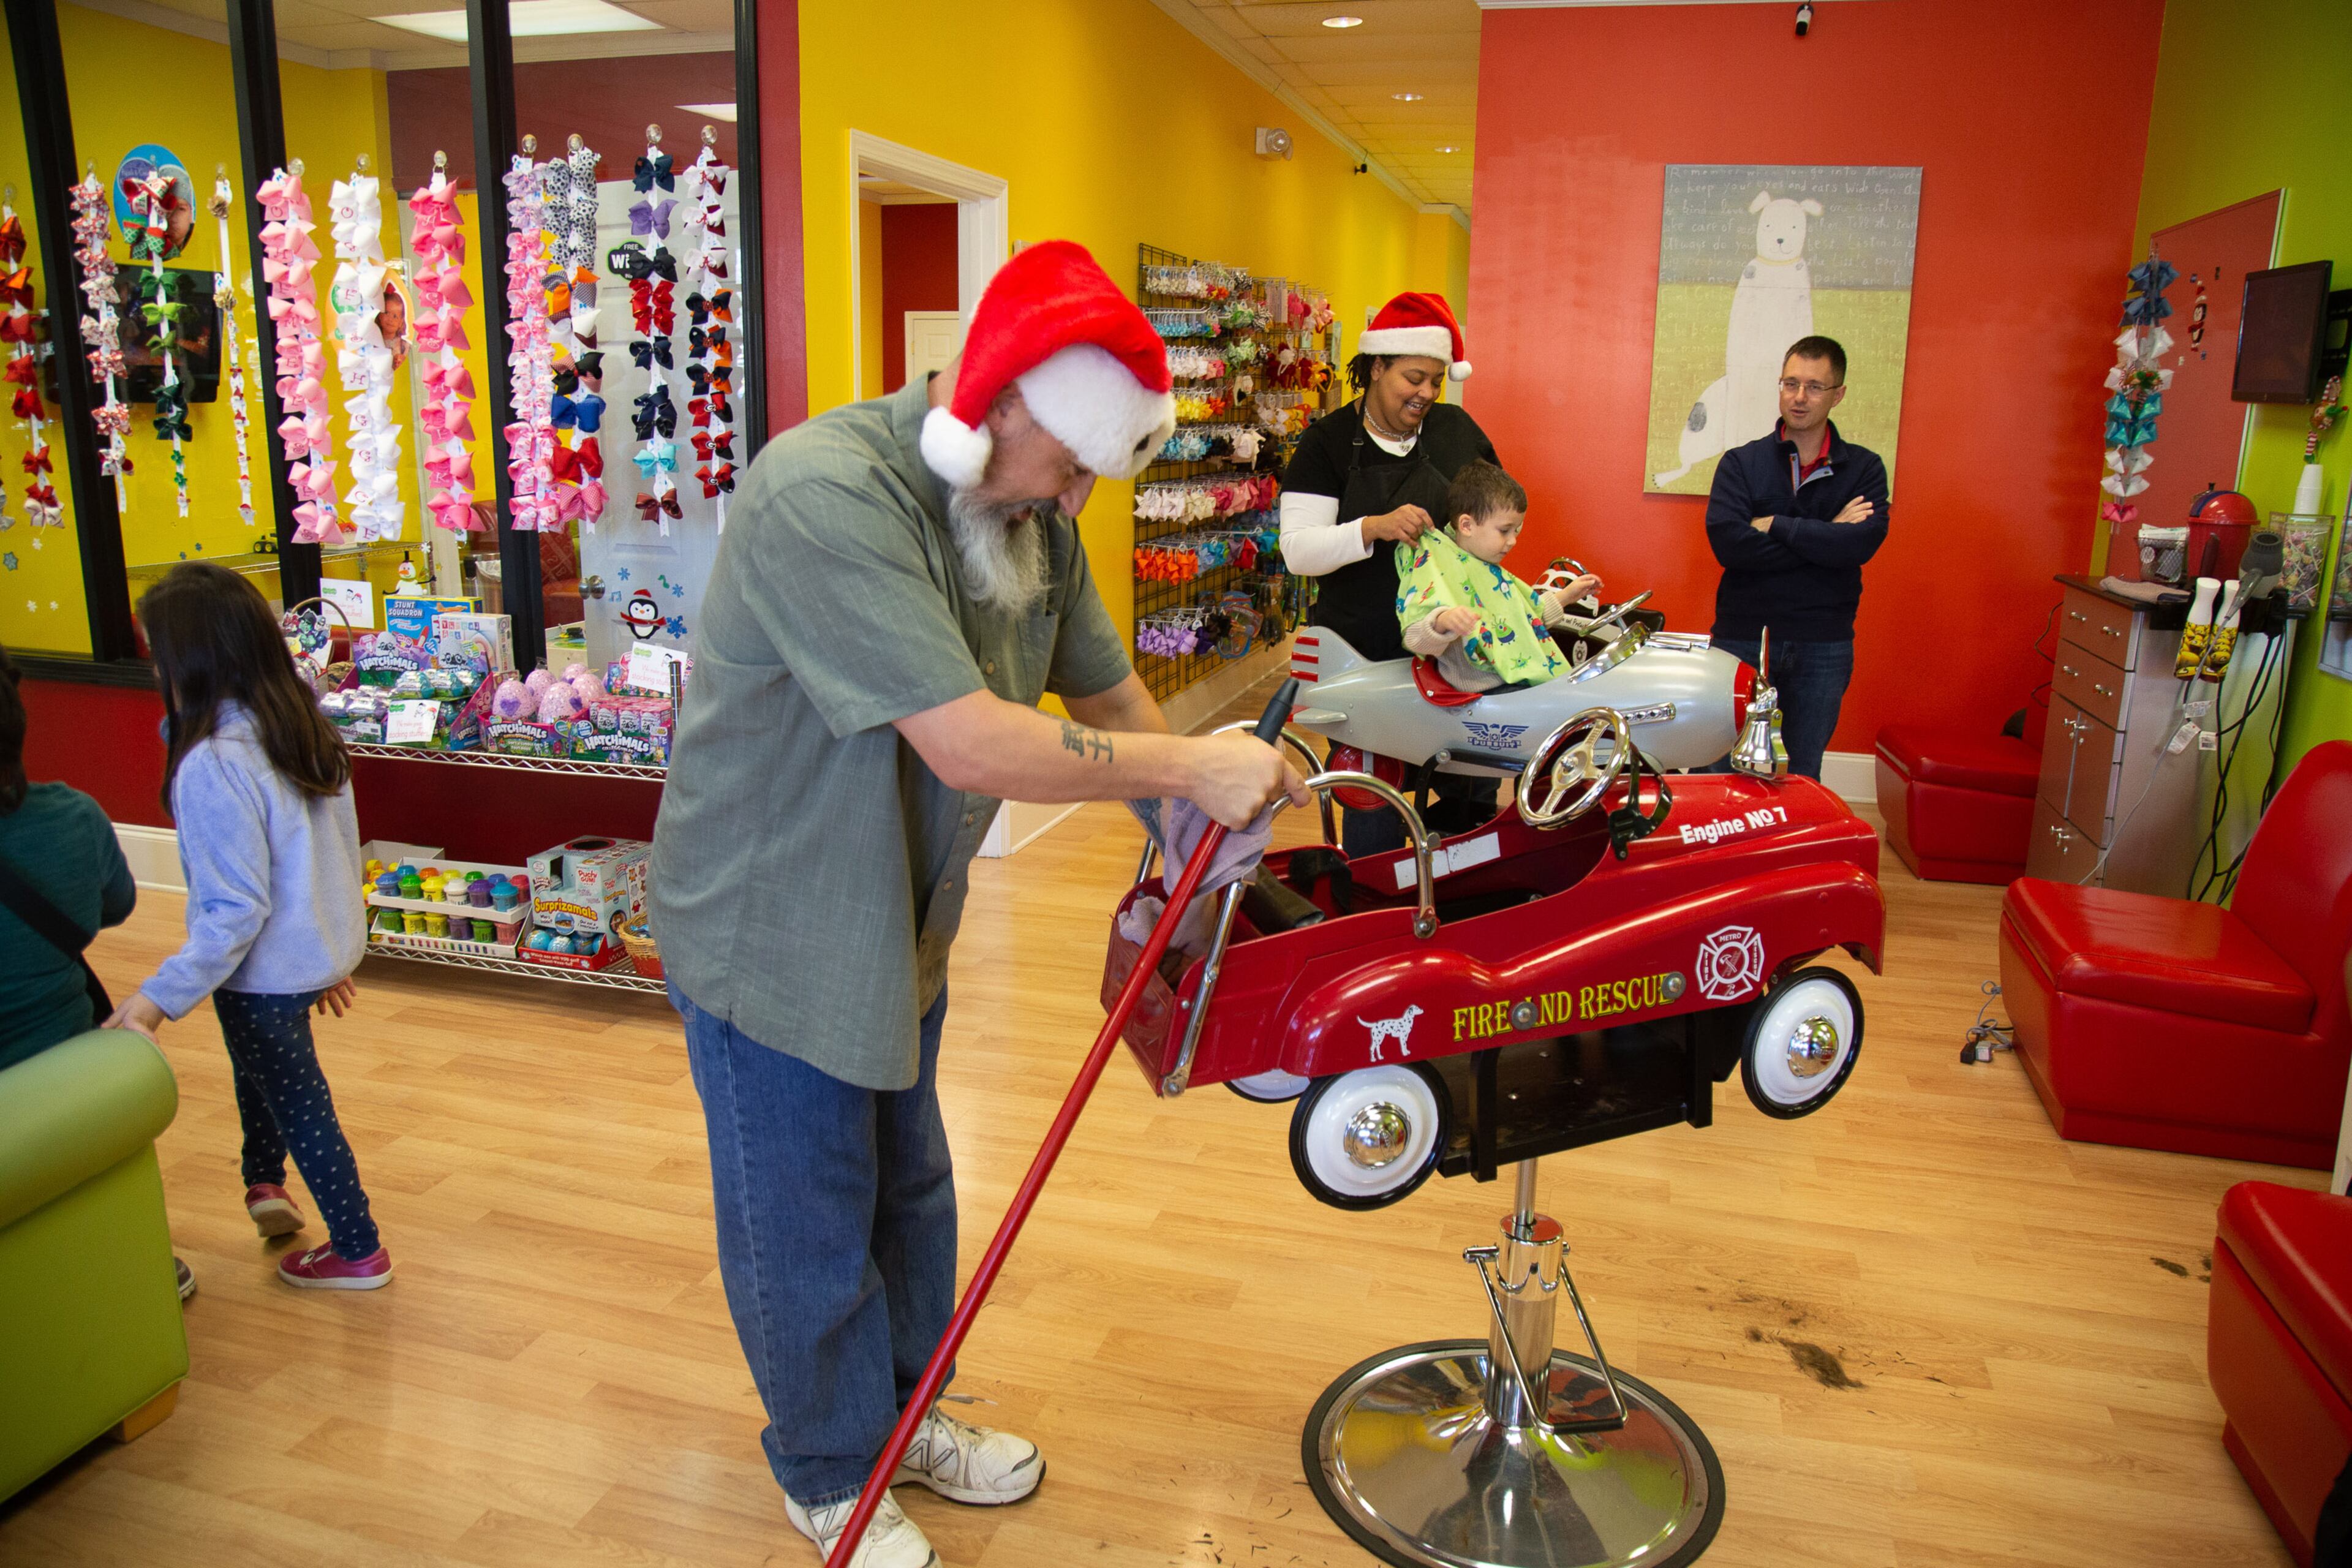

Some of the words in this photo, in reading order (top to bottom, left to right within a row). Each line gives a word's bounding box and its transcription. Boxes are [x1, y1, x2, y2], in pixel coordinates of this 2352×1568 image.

[1811, 167, 1823, 179] go
[1687, 181, 1714, 198] keep
[1724, 182, 1751, 194] your
[1787, 179, 1806, 192] and
[1811, 183, 1838, 192] ears
[1691, 222, 1717, 233] care
[1713, 235, 1727, 251] do
[388, 608, 423, 617] SQUADRON
[1679, 818, 1745, 845] Engine
[1772, 806, 1788, 823] 7
[534, 896, 598, 921] Surprizamals
[1719, 932, 1742, 942] METRO
[1452, 1000, 1513, 1041] FIRE
